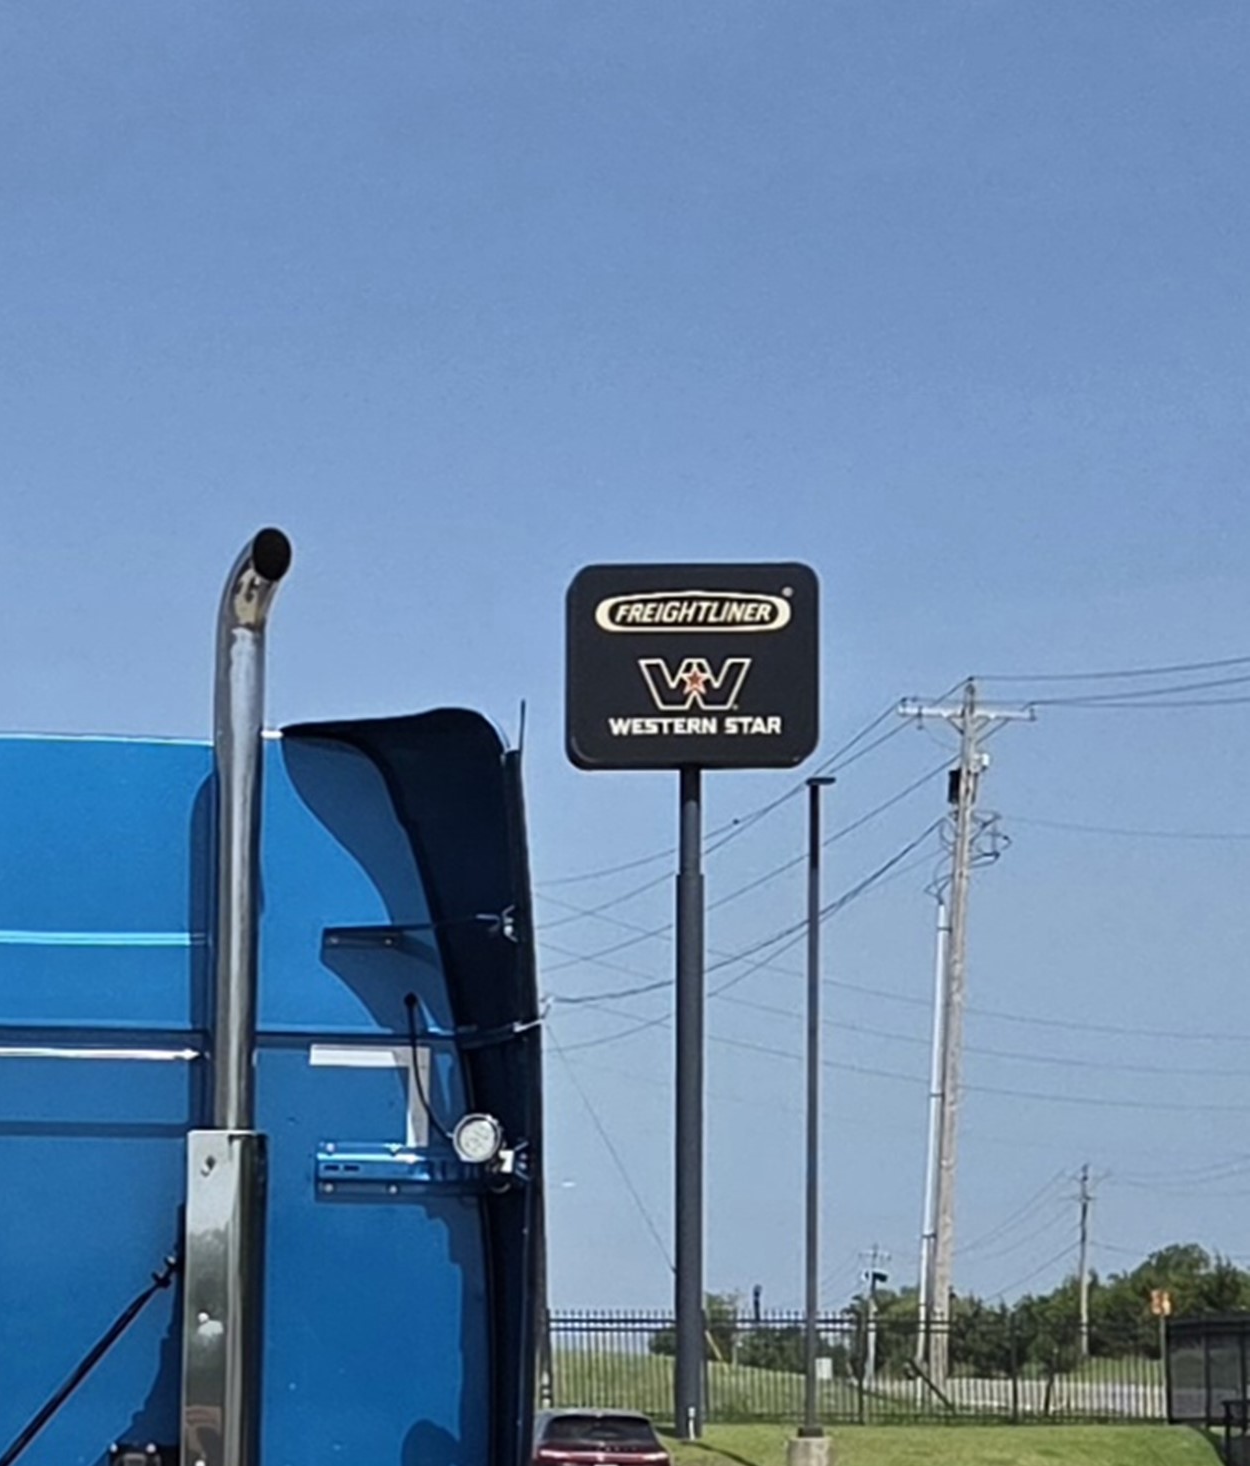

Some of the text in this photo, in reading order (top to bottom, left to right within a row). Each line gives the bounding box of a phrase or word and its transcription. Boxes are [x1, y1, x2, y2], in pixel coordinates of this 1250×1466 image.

[614, 600, 773, 623] FREIGHTLINER
[608, 716, 782, 736] WESTERN STAR
